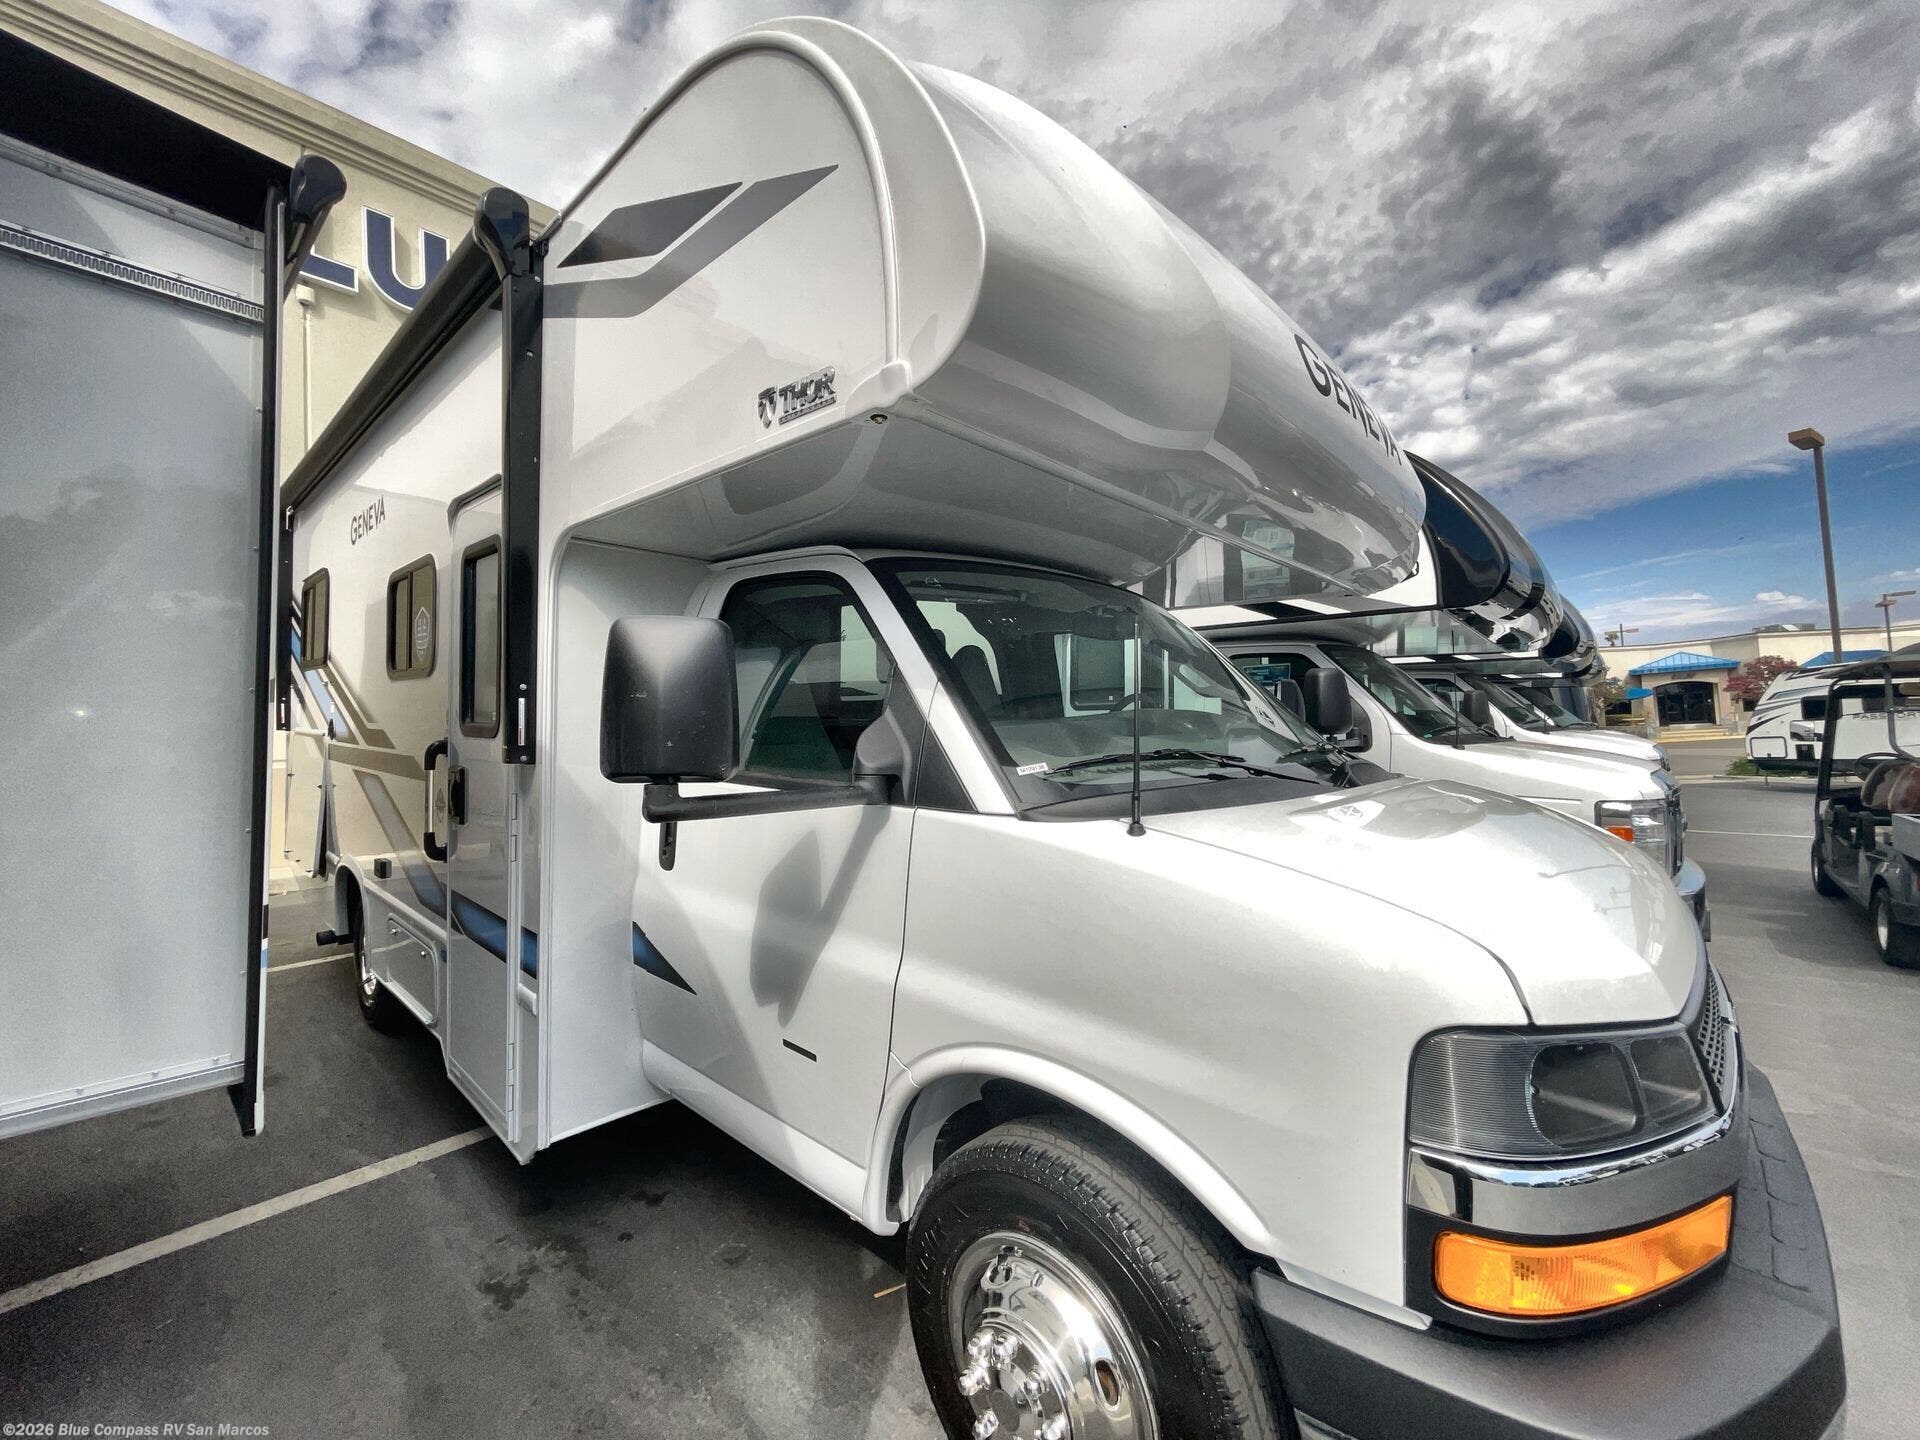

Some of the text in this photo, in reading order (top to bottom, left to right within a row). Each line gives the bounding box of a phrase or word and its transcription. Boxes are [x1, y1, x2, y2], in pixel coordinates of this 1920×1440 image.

[778, 365, 836, 414] THOR
[1293, 333, 1402, 466] GENEVA
[350, 495, 386, 546] GENEVA
[1852, 711, 1920, 720] PASSOR
